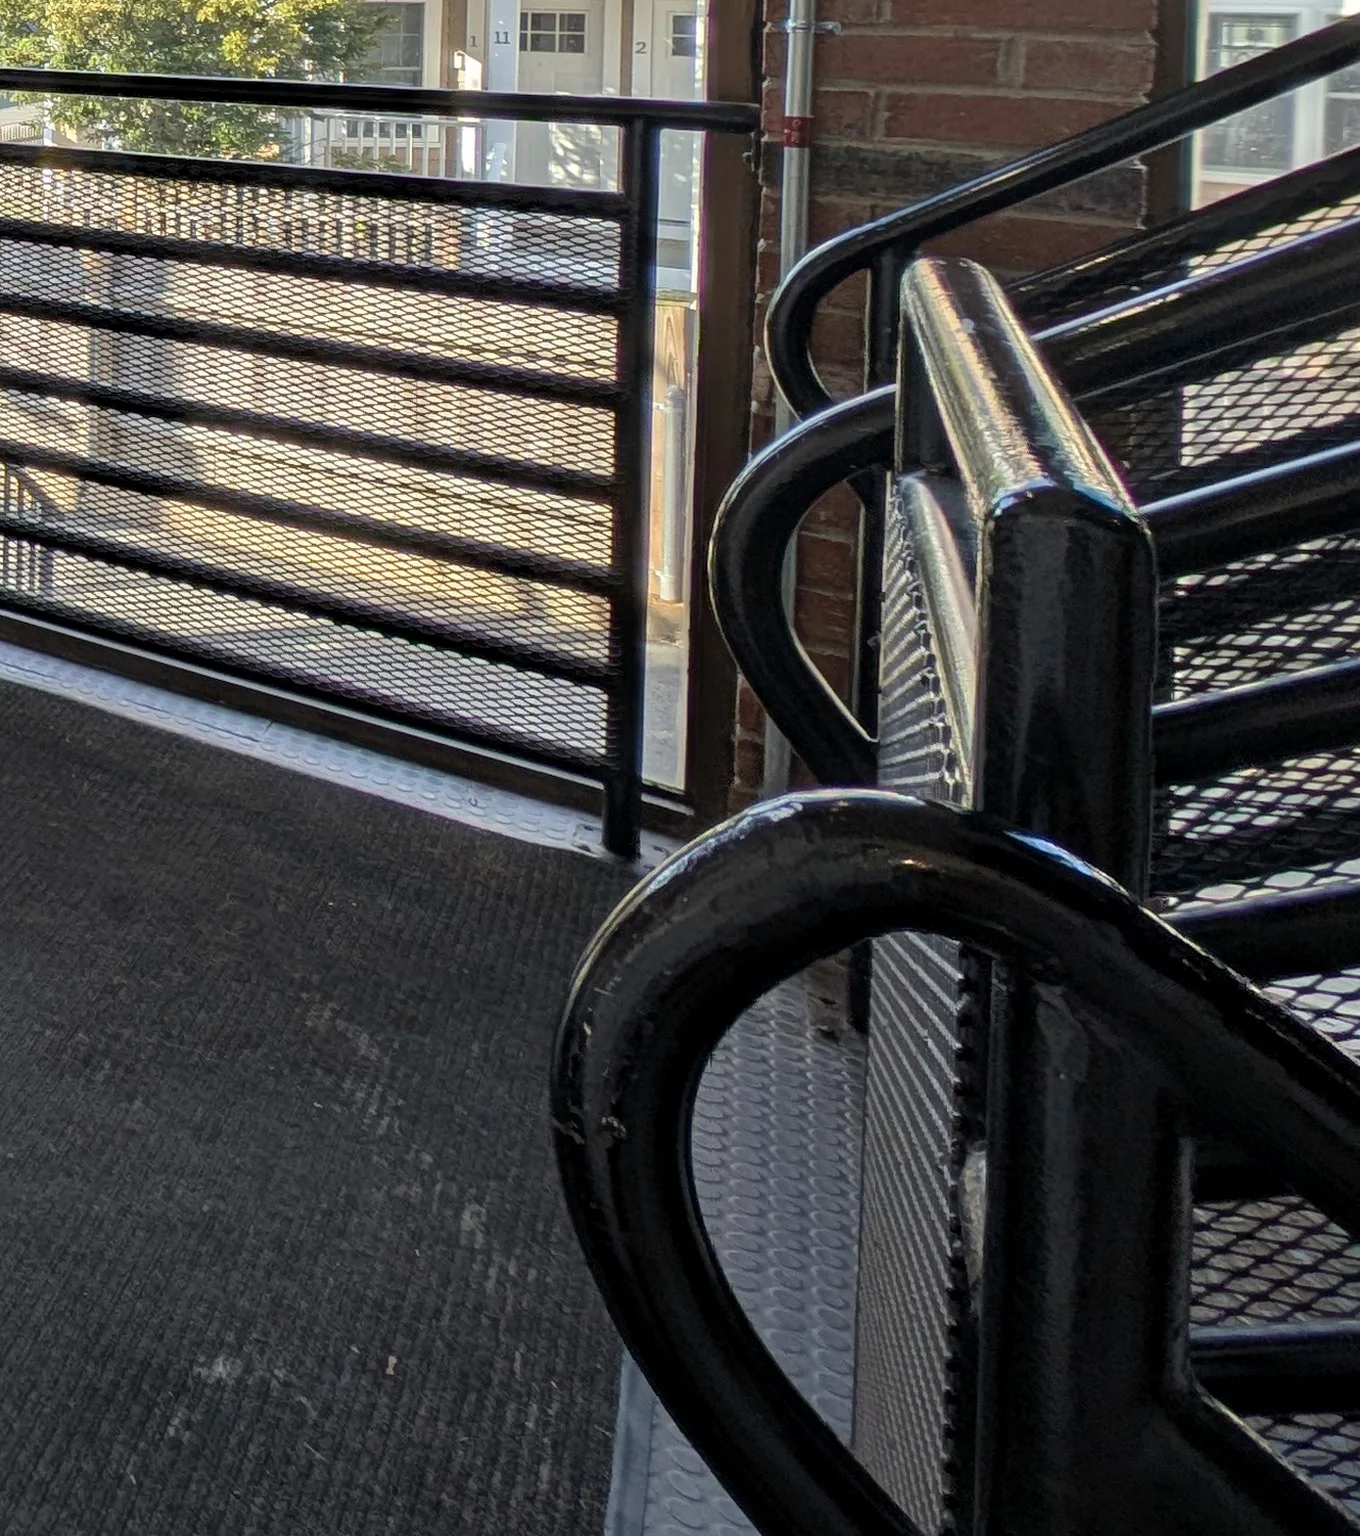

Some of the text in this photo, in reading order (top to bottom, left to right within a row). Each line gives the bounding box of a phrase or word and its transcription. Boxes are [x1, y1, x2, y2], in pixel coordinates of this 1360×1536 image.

[469, 35, 478, 48] 1
[493, 31, 511, 45] 11
[634, 41, 648, 54] 2
